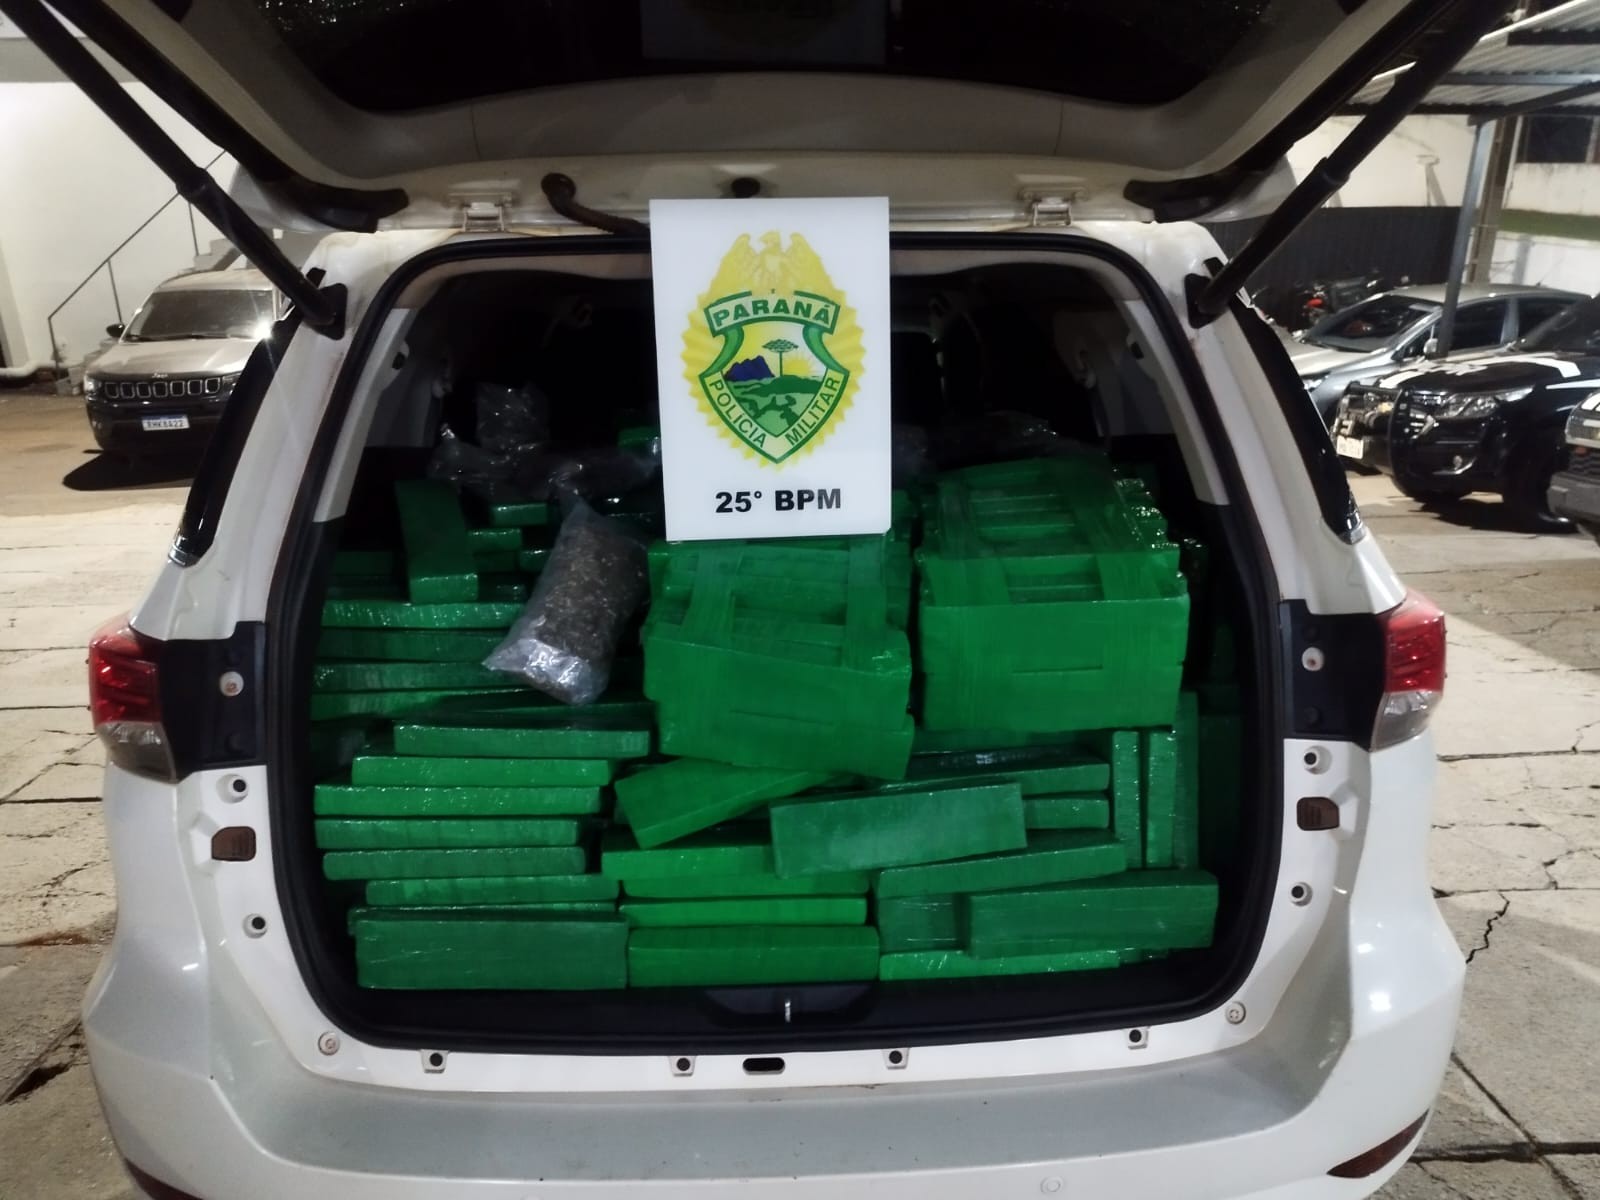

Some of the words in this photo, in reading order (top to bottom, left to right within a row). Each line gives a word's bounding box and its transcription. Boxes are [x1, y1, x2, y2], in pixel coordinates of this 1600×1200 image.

[712, 298, 831, 327] PARANÁ
[709, 378, 767, 448] POLÍCIA
[784, 377, 841, 446] MILITAR
[775, 488, 842, 512] BPM
